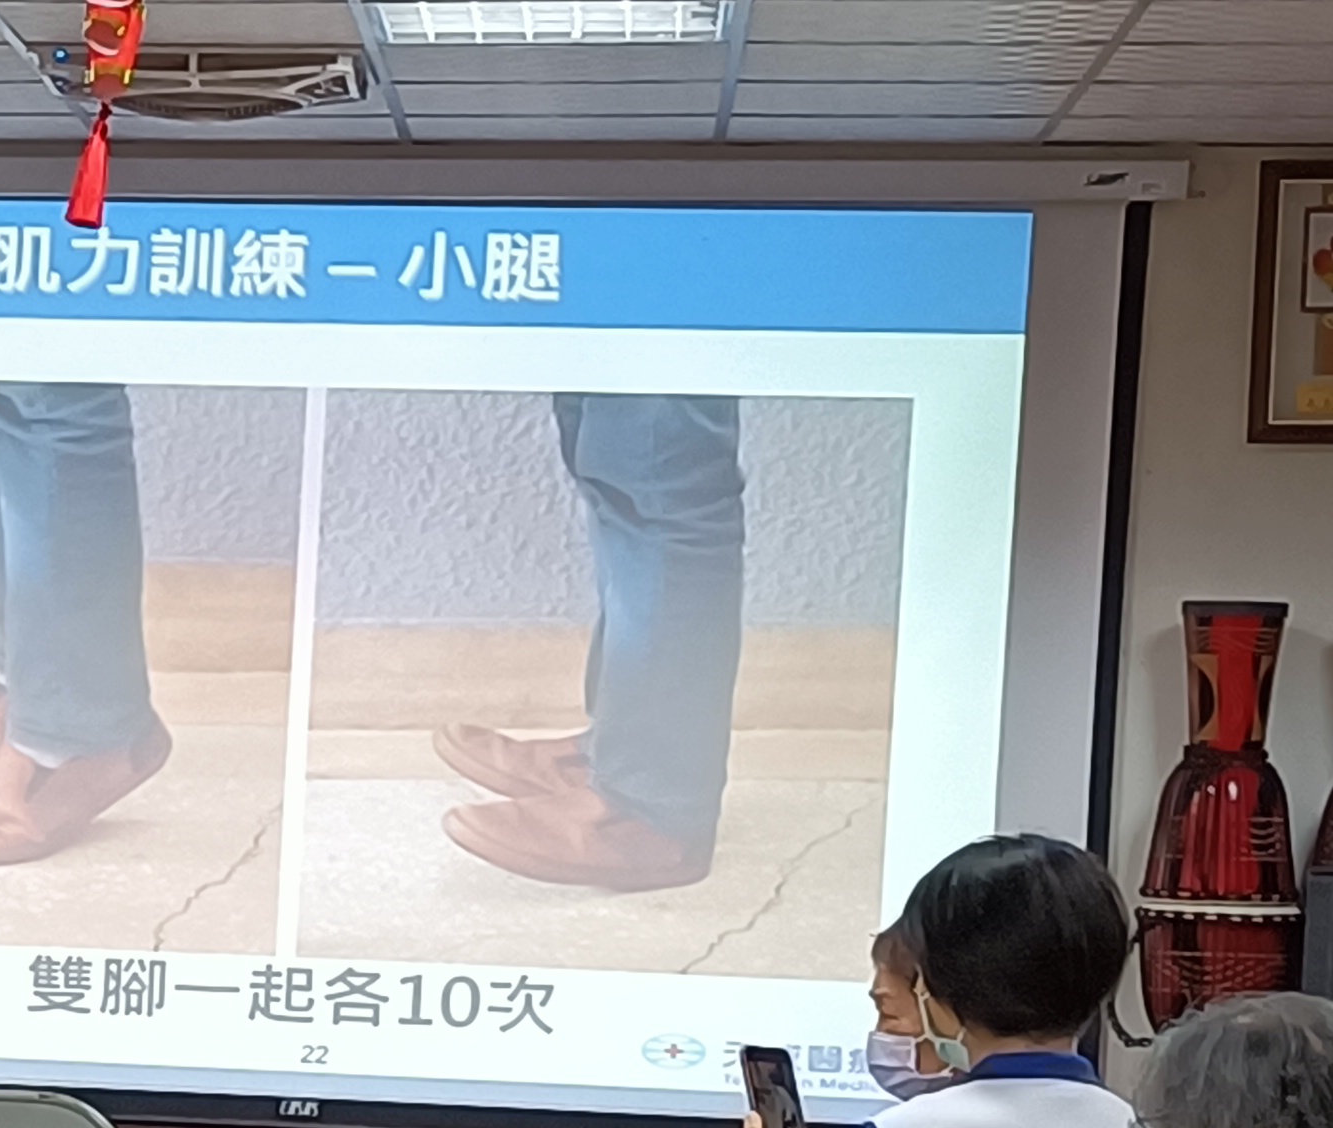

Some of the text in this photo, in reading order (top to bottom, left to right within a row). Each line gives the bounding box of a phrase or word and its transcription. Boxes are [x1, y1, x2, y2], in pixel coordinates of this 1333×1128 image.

[398, 230, 562, 302] 小腿
[26, 954, 555, 1035] 雙腳一起各10次
[300, 1044, 330, 1065] 22
